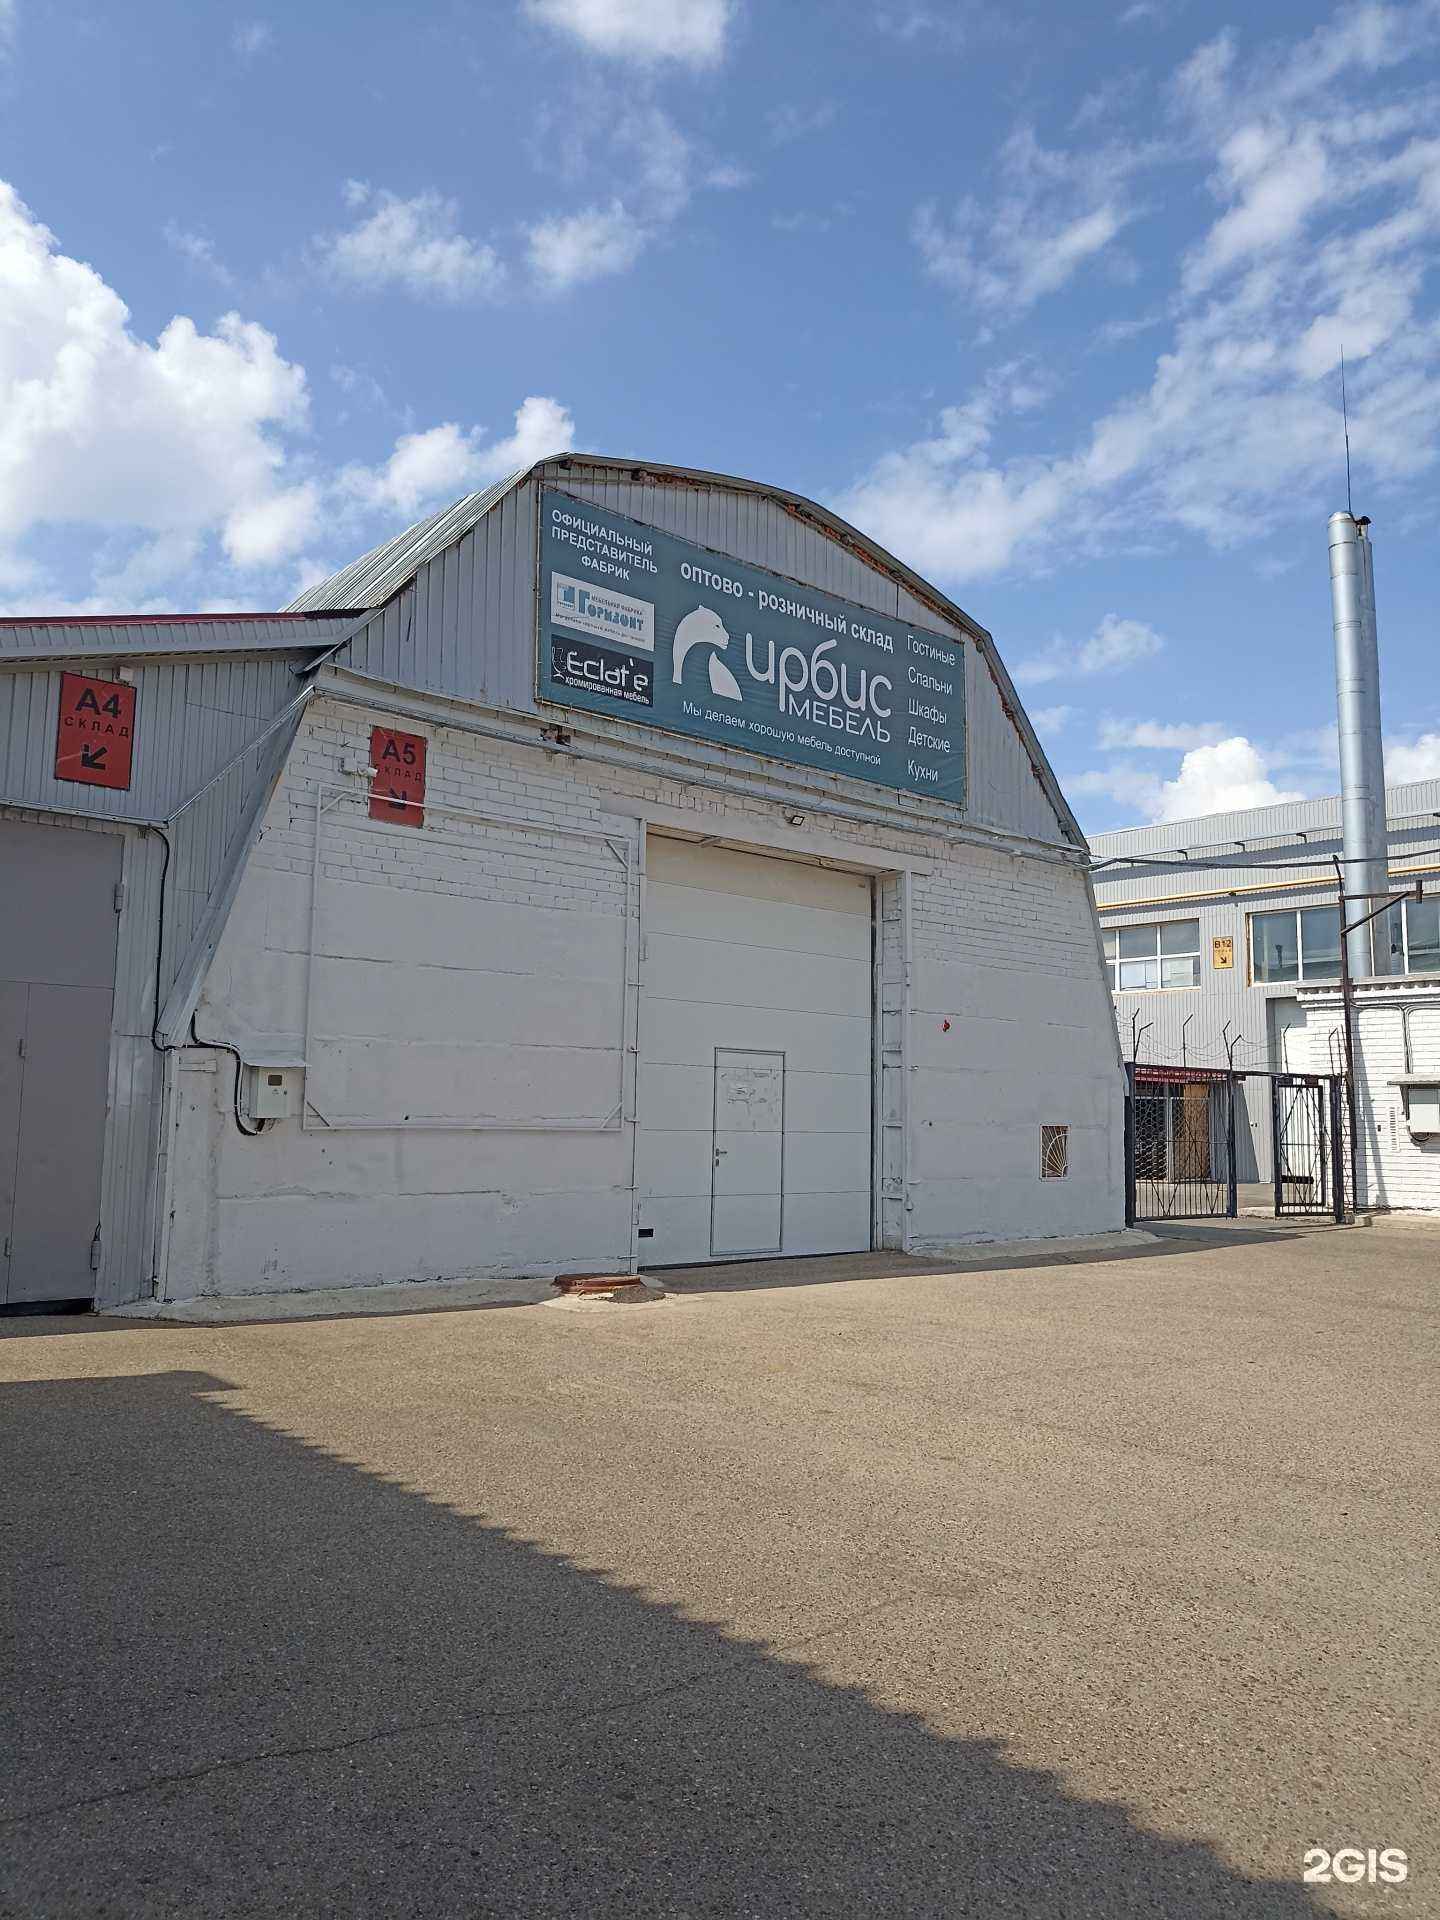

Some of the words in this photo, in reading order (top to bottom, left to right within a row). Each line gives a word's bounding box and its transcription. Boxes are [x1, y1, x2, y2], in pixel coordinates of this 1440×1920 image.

[552, 509, 653, 556] ОФИЦИАЛЬНЫЙ
[551, 526, 658, 574] ПРЕДСТАВИТЕЛЬ
[581, 555, 630, 581] ФАБРИК
[758, 590, 847, 635] розничный
[851, 623, 894, 654] склад
[907, 635, 956, 666] Гостиные
[565, 675, 623, 697] хромированная
[623, 691, 650, 705] мебель
[907, 666, 953, 696] Спальни
[788, 694, 891, 744] МЕБЕЛЬ
[908, 698, 947, 725] Шкафы
[64, 717, 129, 738] СКЛАД
[683, 701, 702, 716] Мы
[704, 708, 746, 729] делаем
[749, 721, 795, 743] хорошую
[797, 734, 833, 753] мебель
[834, 744, 881, 766] доступной
[908, 726, 951, 753] Детские
[907, 759, 939, 782] Кухни
